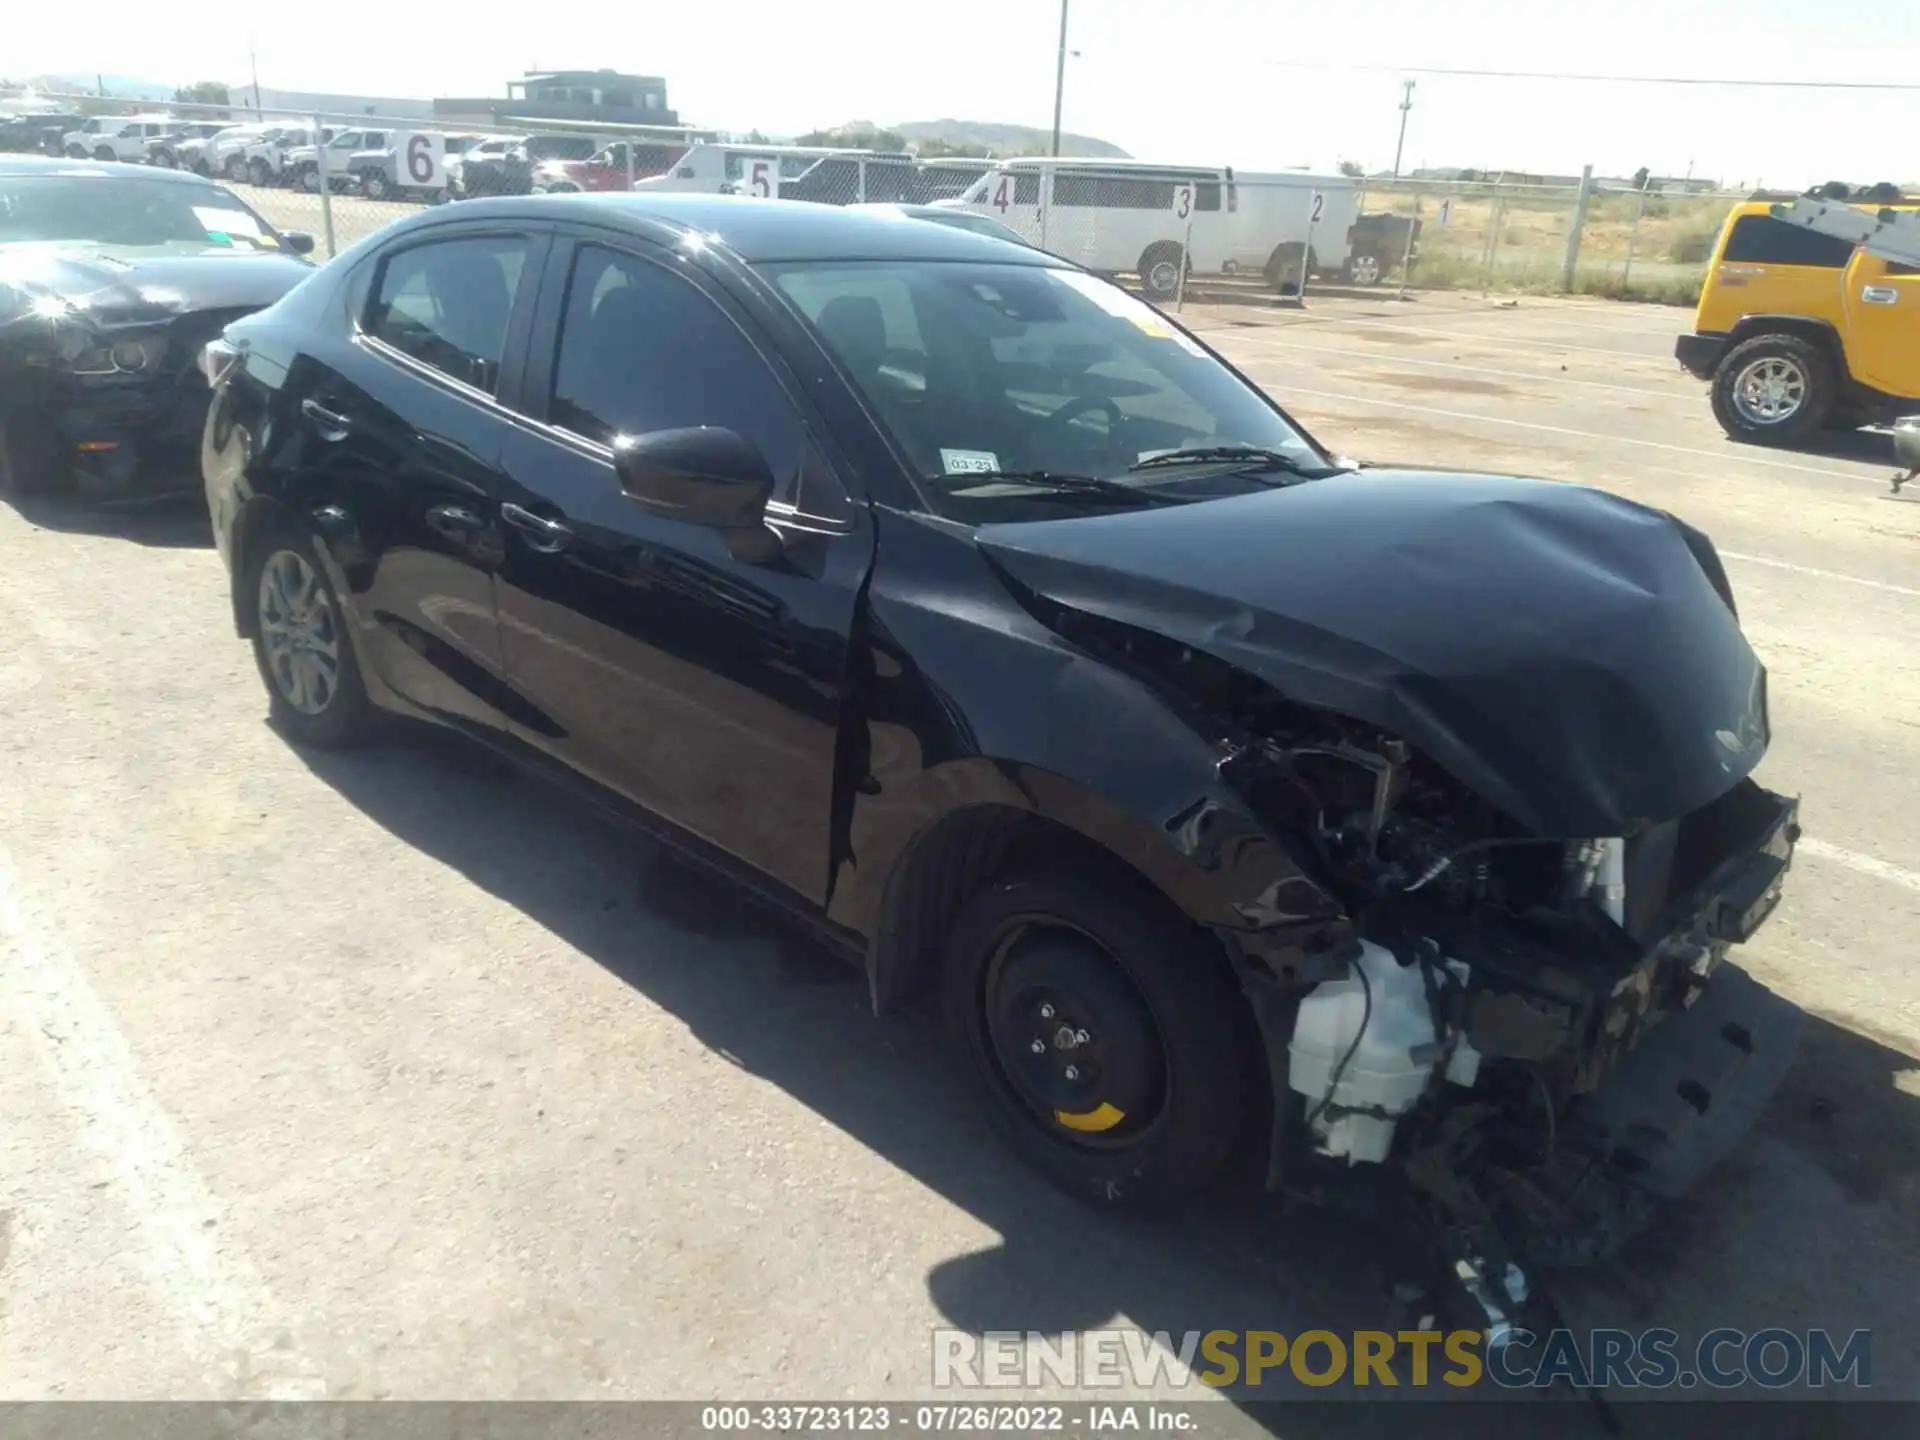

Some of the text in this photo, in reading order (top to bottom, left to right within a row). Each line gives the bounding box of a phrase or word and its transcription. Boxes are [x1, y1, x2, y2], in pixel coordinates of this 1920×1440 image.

[407, 134, 434, 184] 6
[751, 162, 771, 199] 5
[993, 178, 1009, 214] 4
[1177, 188, 1190, 220] 3
[1310, 194, 1323, 222] 2
[1442, 199, 1449, 224] 1
